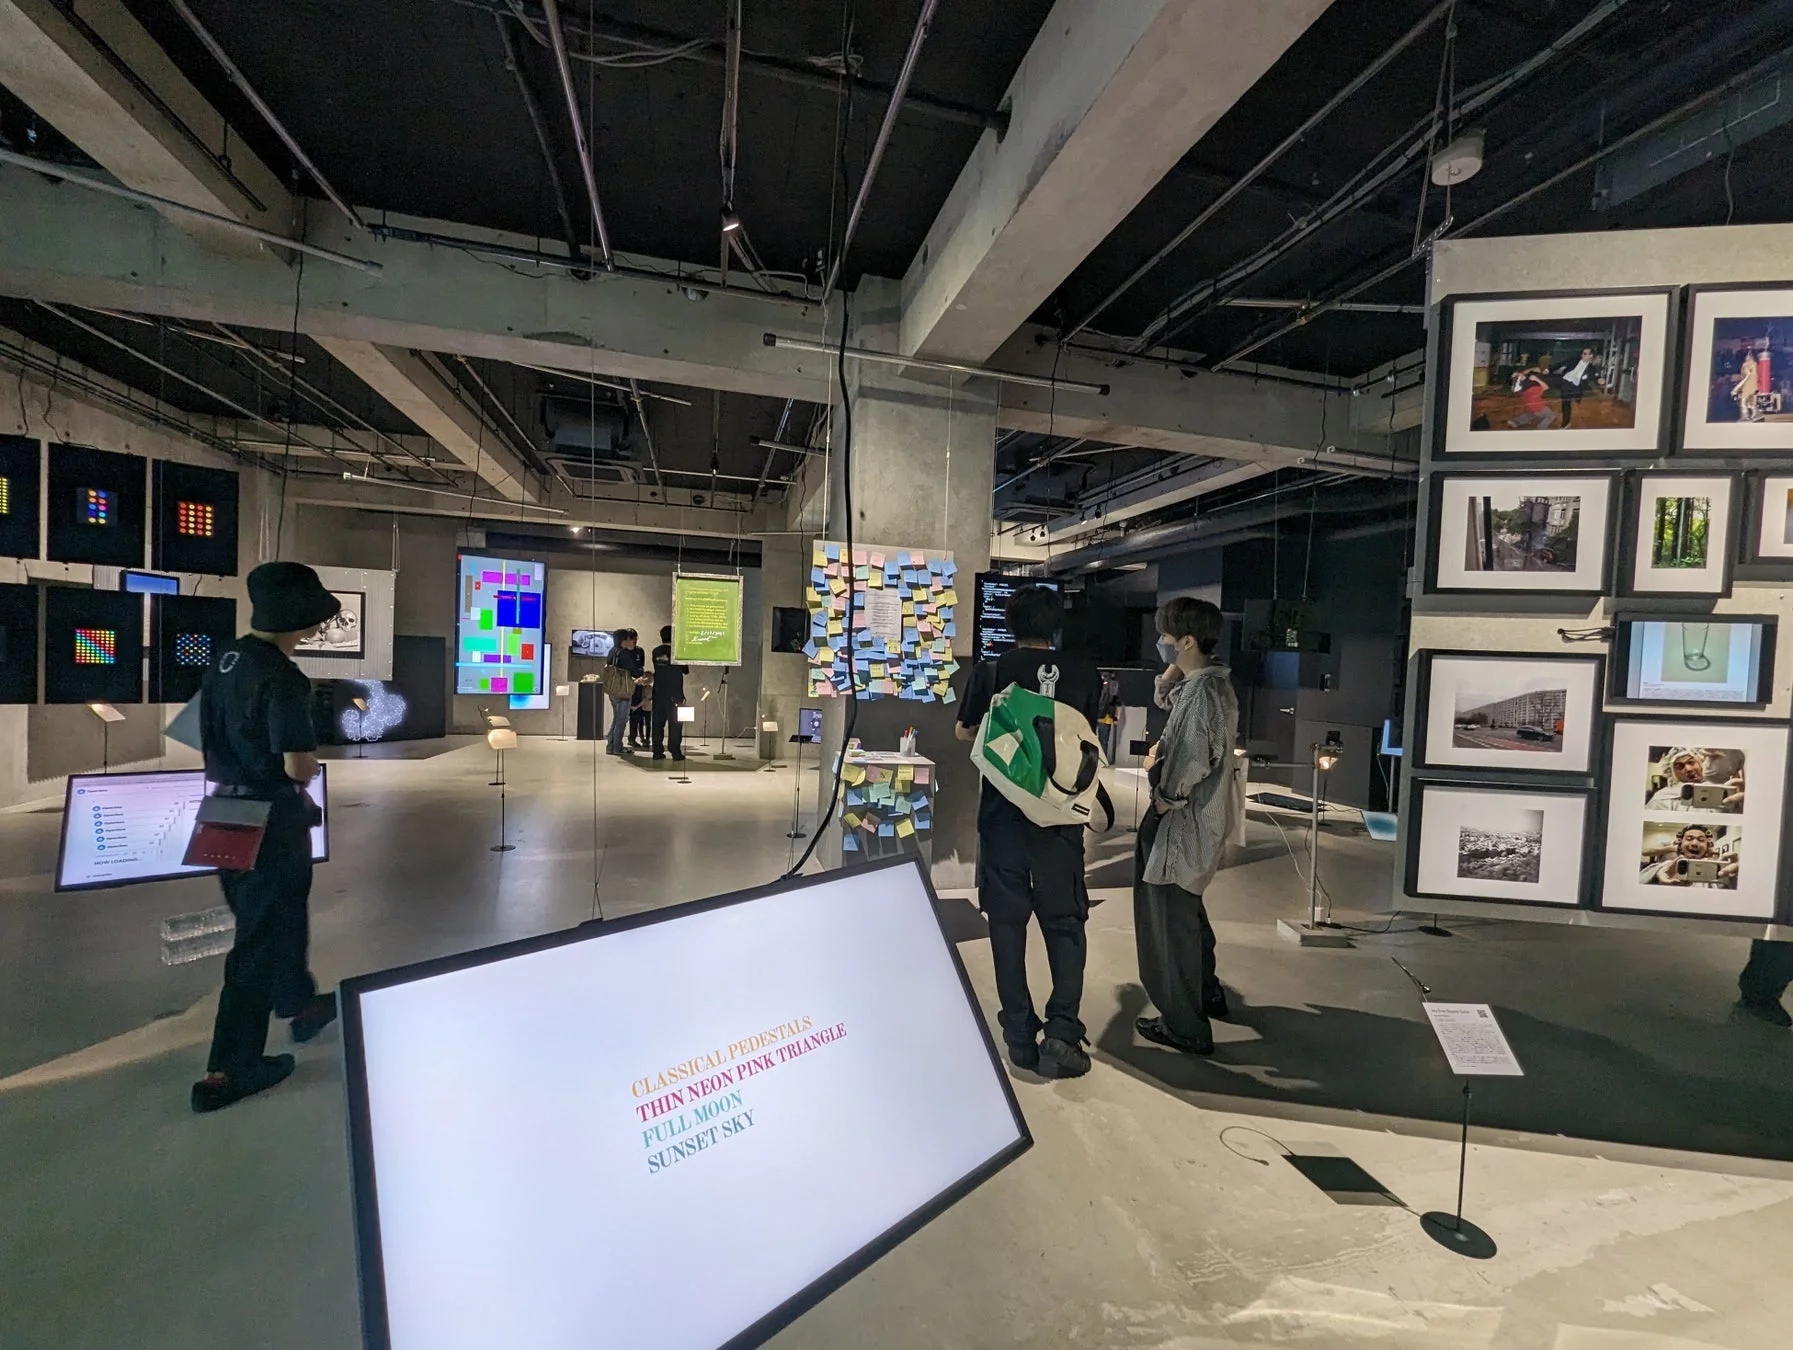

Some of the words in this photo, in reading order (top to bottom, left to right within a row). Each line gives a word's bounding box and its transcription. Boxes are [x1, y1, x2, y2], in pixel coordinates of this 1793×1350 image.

[631, 1049, 727, 1098] CLASSICAL
[728, 1015, 813, 1061] PEDESTALS
[635, 1089, 685, 1123] THIN
[686, 1068, 735, 1103] NEON
[737, 1052, 777, 1081] PINK
[776, 1022, 848, 1064] TRIANGLE
[641, 1118, 693, 1150] FULL
[694, 1089, 744, 1125] MOON
[647, 1126, 720, 1174] SUNSET
[722, 1108, 756, 1139] SKY
